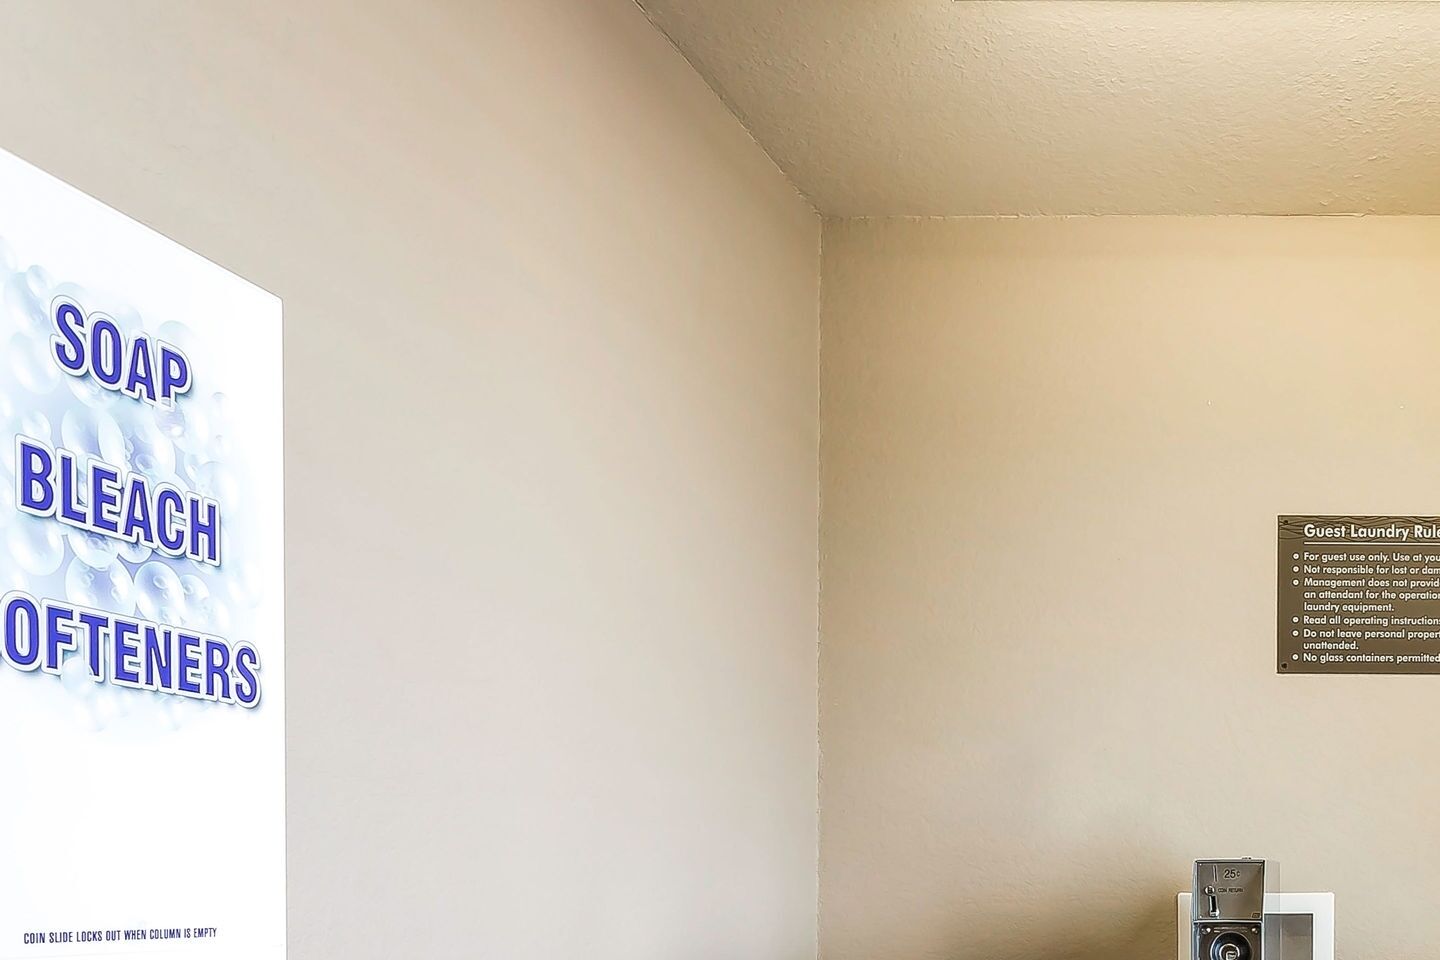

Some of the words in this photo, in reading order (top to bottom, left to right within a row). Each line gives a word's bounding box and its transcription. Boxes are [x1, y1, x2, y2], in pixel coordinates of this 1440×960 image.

[54, 301, 189, 403] SOAP
[19, 440, 217, 562] BLEACH
[1303, 523, 1346, 538] Guest
[1350, 524, 1410, 542] Laundry
[1303, 551, 1320, 561] For
[1321, 553, 1347, 563] guest
[1368, 552, 1390, 564] only.
[1392, 552, 1411, 562] Use
[1412, 553, 1422, 562] at
[1303, 564, 1321, 574] Not
[1322, 564, 1374, 576] responsible
[1376, 564, 1390, 574] for
[1391, 565, 1408, 575] lost
[1303, 577, 1366, 589] Management
[1367, 577, 1390, 587] does
[1392, 578, 1408, 587] not
[1318, 589, 1364, 599] attendant
[1365, 589, 1380, 599] for
[1381, 589, 1397, 600] the
[1304, 601, 1340, 613] laundry
[1342, 602, 1395, 613] equipment.
[1303, 615, 1327, 625] Read
[1329, 615, 1341, 625] all
[1343, 615, 1389, 627] operating
[1303, 628, 1317, 638] Do
[1319, 629, 1335, 638] not
[1337, 628, 1362, 638] leave
[1364, 628, 1405, 640] personal
[3, 597, 258, 704] OFTENERS
[1303, 640, 1359, 650] unattended.
[1303, 652, 1318, 662] No
[1319, 652, 1344, 664] glass
[1346, 652, 1394, 662] containers
[23, 932, 46, 945] COIN
[49, 931, 74, 944] SLIDE
[76, 930, 103, 943] LOCKS
[105, 930, 121, 942] OUT
[124, 929, 147, 941] WHEN
[149, 928, 182, 940] COLUMN
[184, 928, 191, 939] IS
[193, 927, 218, 938] EMPTY
